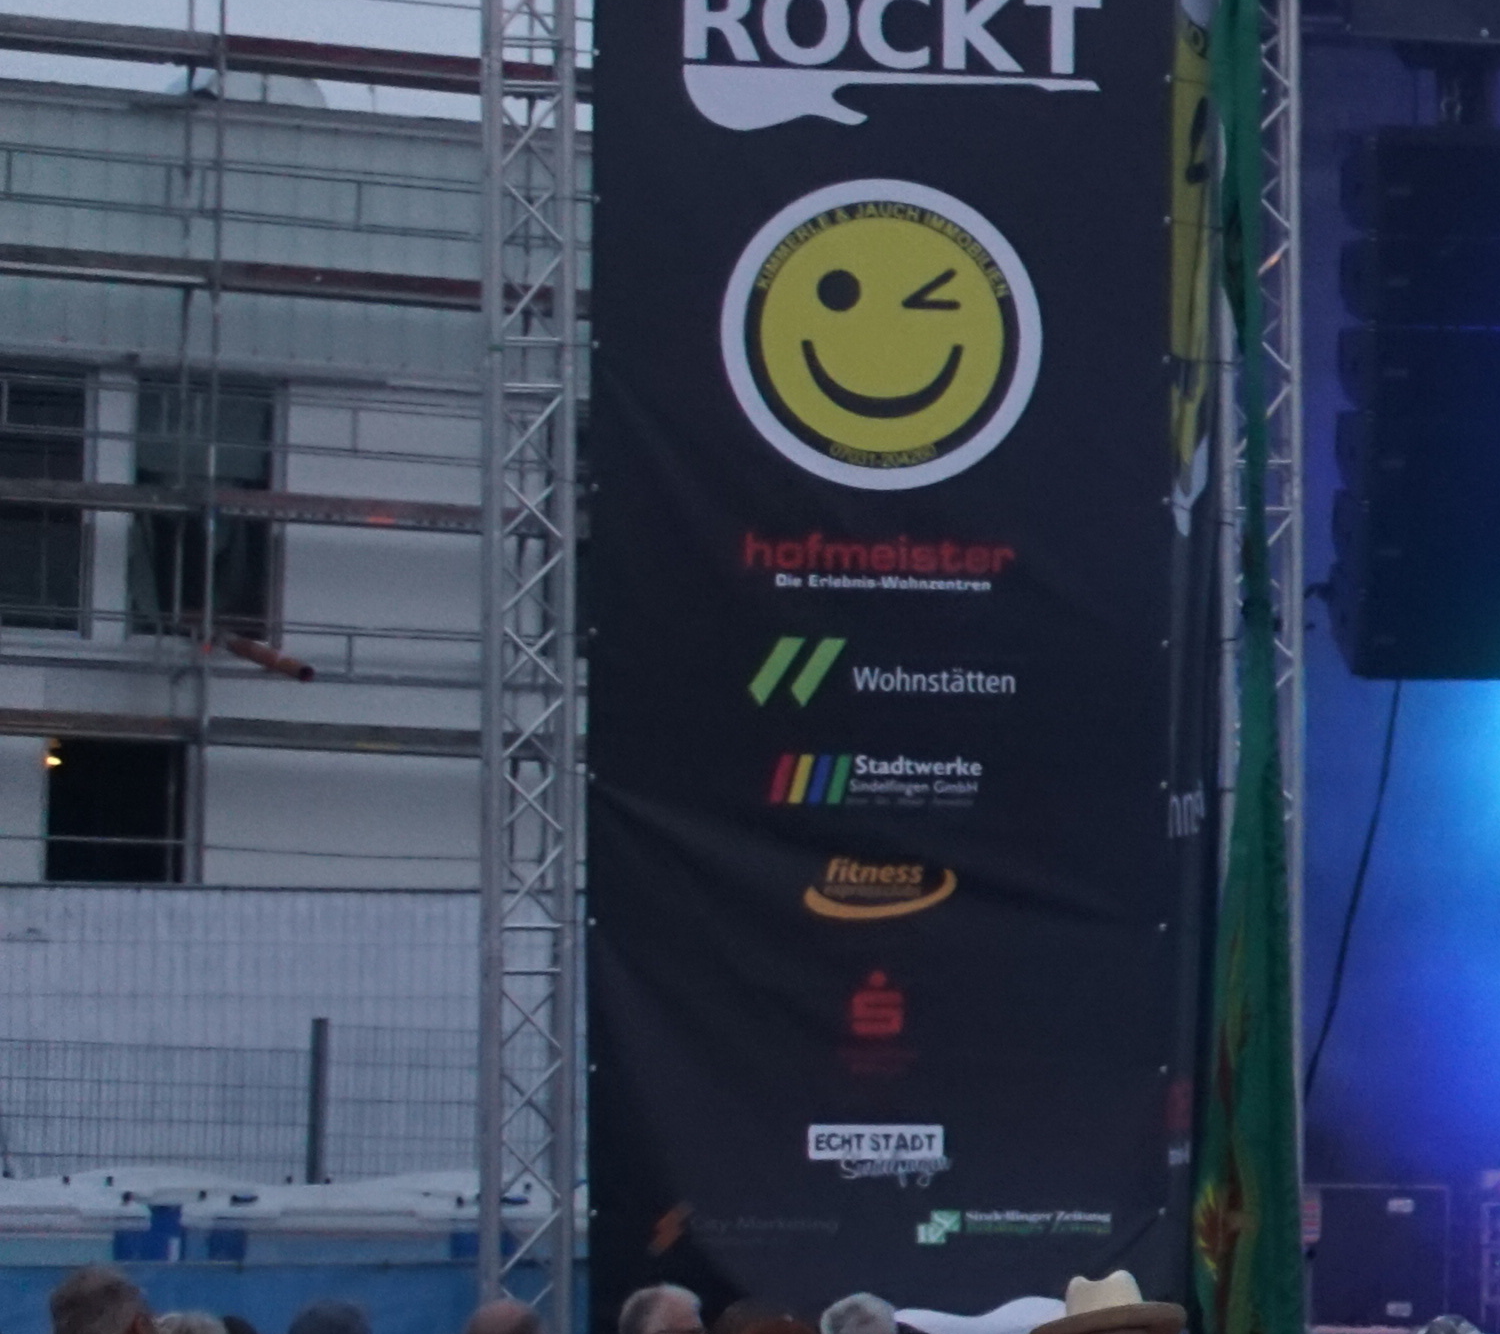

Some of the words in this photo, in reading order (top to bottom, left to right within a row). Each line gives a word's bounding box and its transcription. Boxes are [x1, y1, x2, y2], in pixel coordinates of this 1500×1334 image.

[855, 203, 920, 221] JAUCH
[743, 531, 1016, 575] hofmeister
[774, 572, 803, 588] Die
[853, 666, 1018, 695] Wohnstätten
[854, 753, 984, 777] Stadtwerke
[825, 854, 925, 884] fitness
[814, 1133, 865, 1152] ECHT
[869, 1132, 937, 1152] STADT
